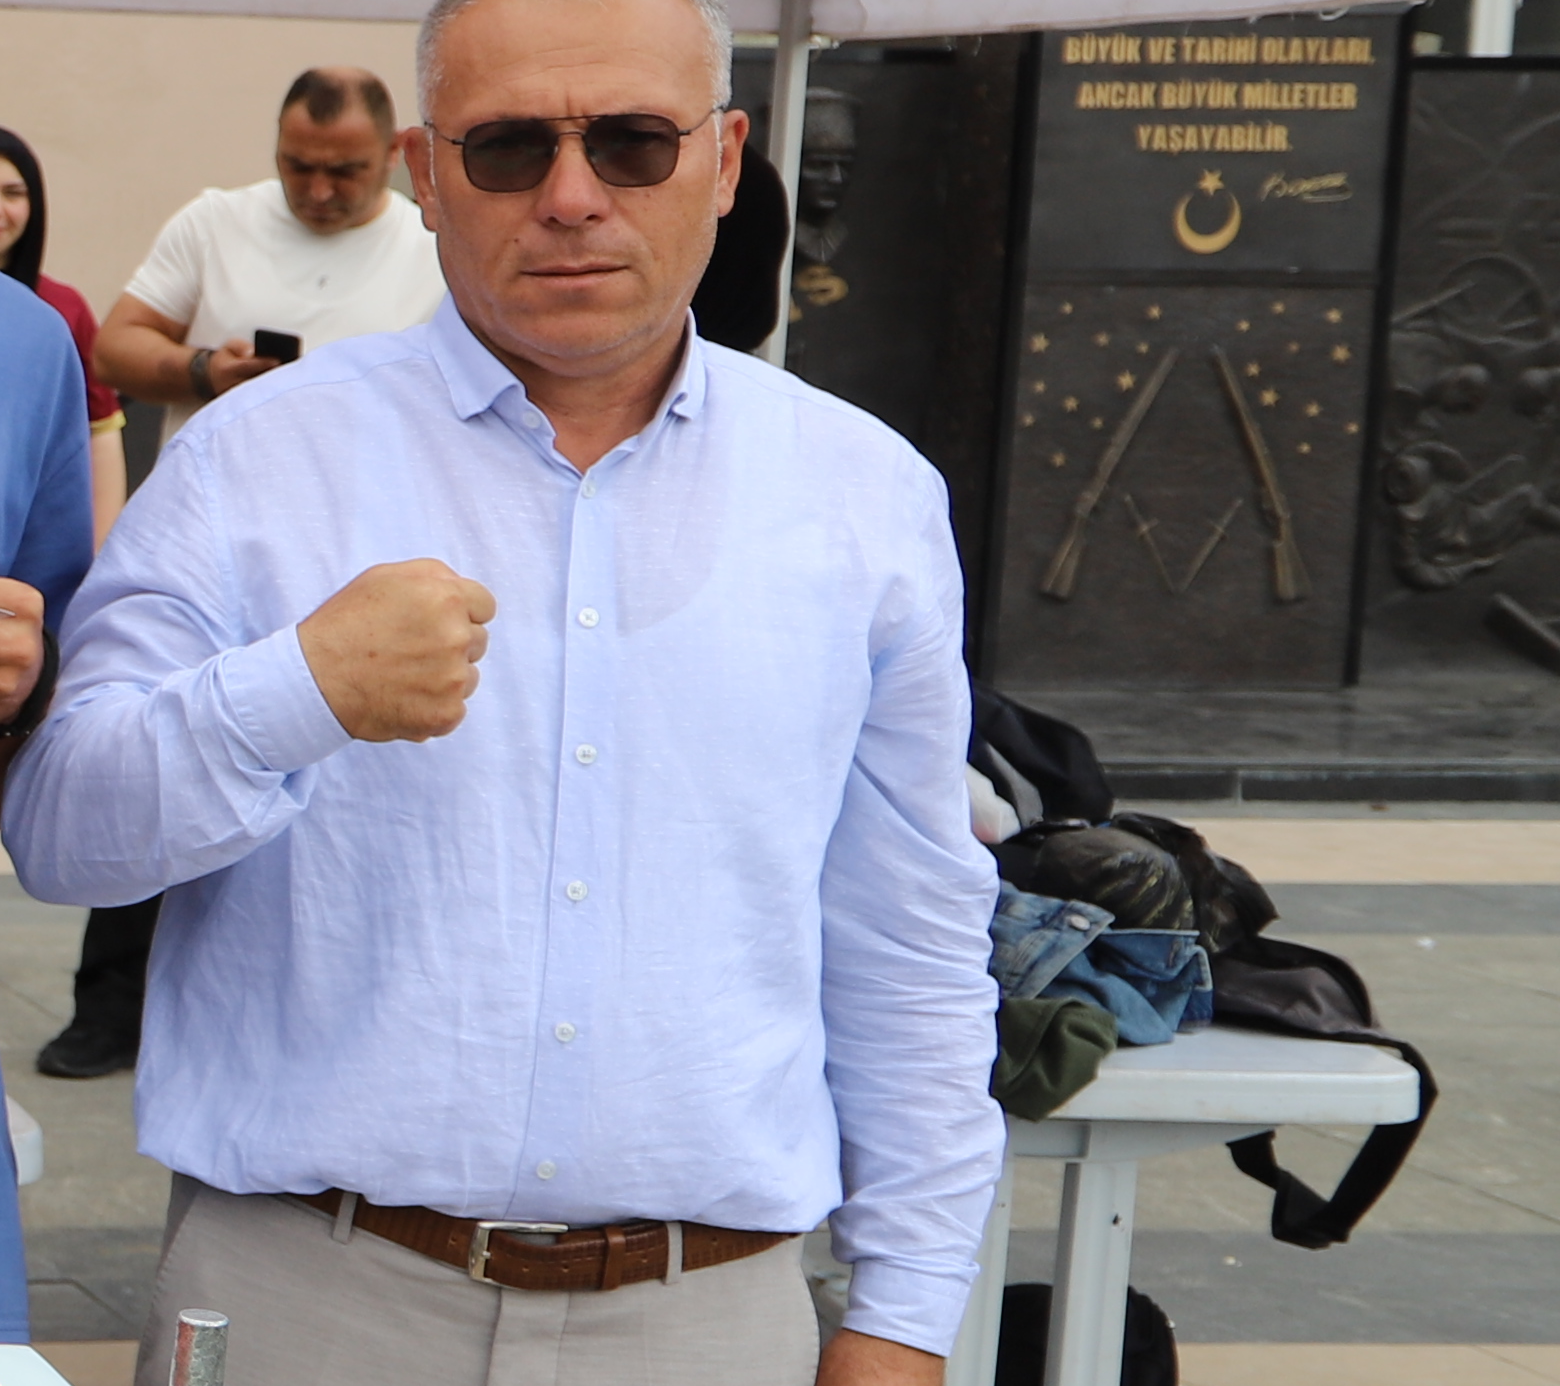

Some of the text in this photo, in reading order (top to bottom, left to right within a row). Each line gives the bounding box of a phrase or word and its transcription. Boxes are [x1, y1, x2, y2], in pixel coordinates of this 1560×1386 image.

[1063, 33, 1141, 63] BÜYÜK
[1148, 37, 1175, 63] VE
[1183, 34, 1257, 63] TARİHİ
[1077, 78, 1358, 109] ANCAK BÜYÜK MİLLETLER
